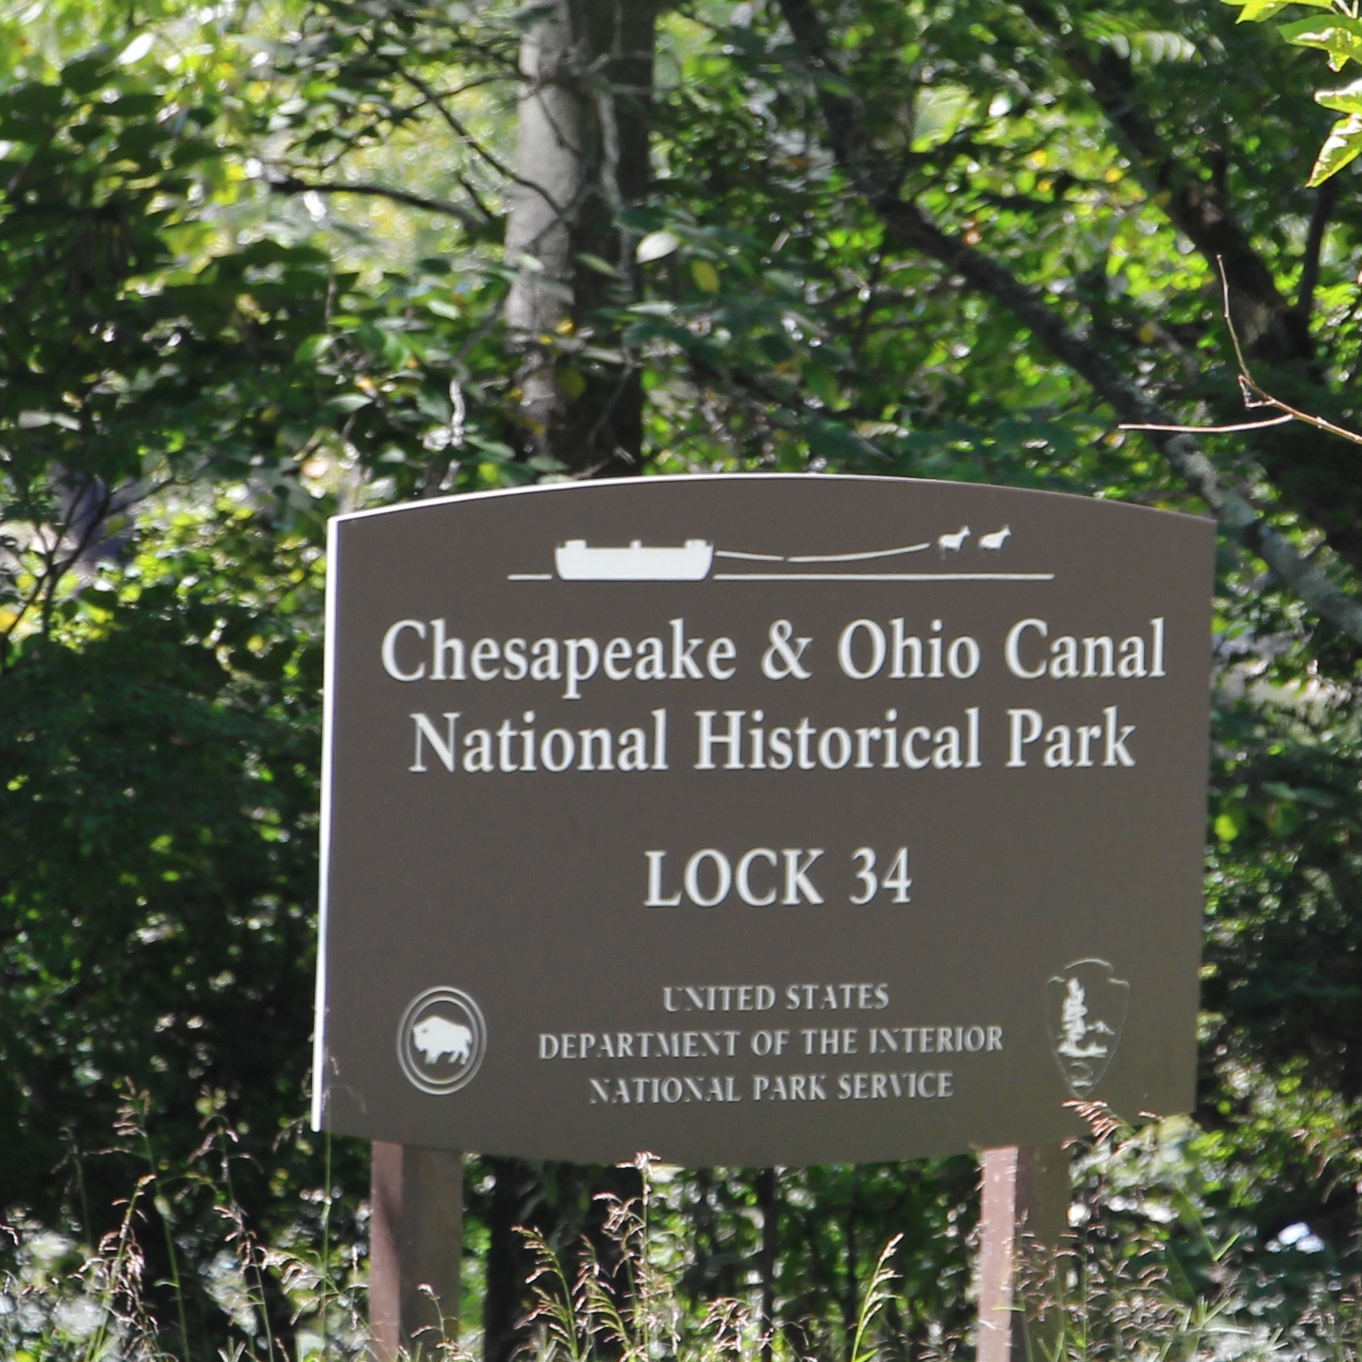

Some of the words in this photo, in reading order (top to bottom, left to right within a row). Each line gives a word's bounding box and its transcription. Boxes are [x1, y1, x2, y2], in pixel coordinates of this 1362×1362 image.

[381, 617, 737, 700] Chesapeake
[760, 618, 814, 680] &
[837, 617, 981, 680] Ohio
[1004, 616, 1167, 680] Canal
[408, 708, 669, 773] National
[692, 706, 982, 770] Historical
[1005, 705, 1136, 768] Park
[643, 847, 825, 907] LOCK
[849, 846, 913, 905] 34
[662, 984, 776, 1012] UNITED
[785, 982, 890, 1010] STATES
[538, 1030, 742, 1060] DEPARTMENT
[750, 1029, 790, 1056] OF
[800, 1027, 858, 1055] THE
[868, 1024, 1003, 1054] INTERIOR
[589, 1075, 742, 1104] NATIONAL
[752, 1073, 827, 1101] PARK
[837, 1071, 954, 1100] SERVICE
